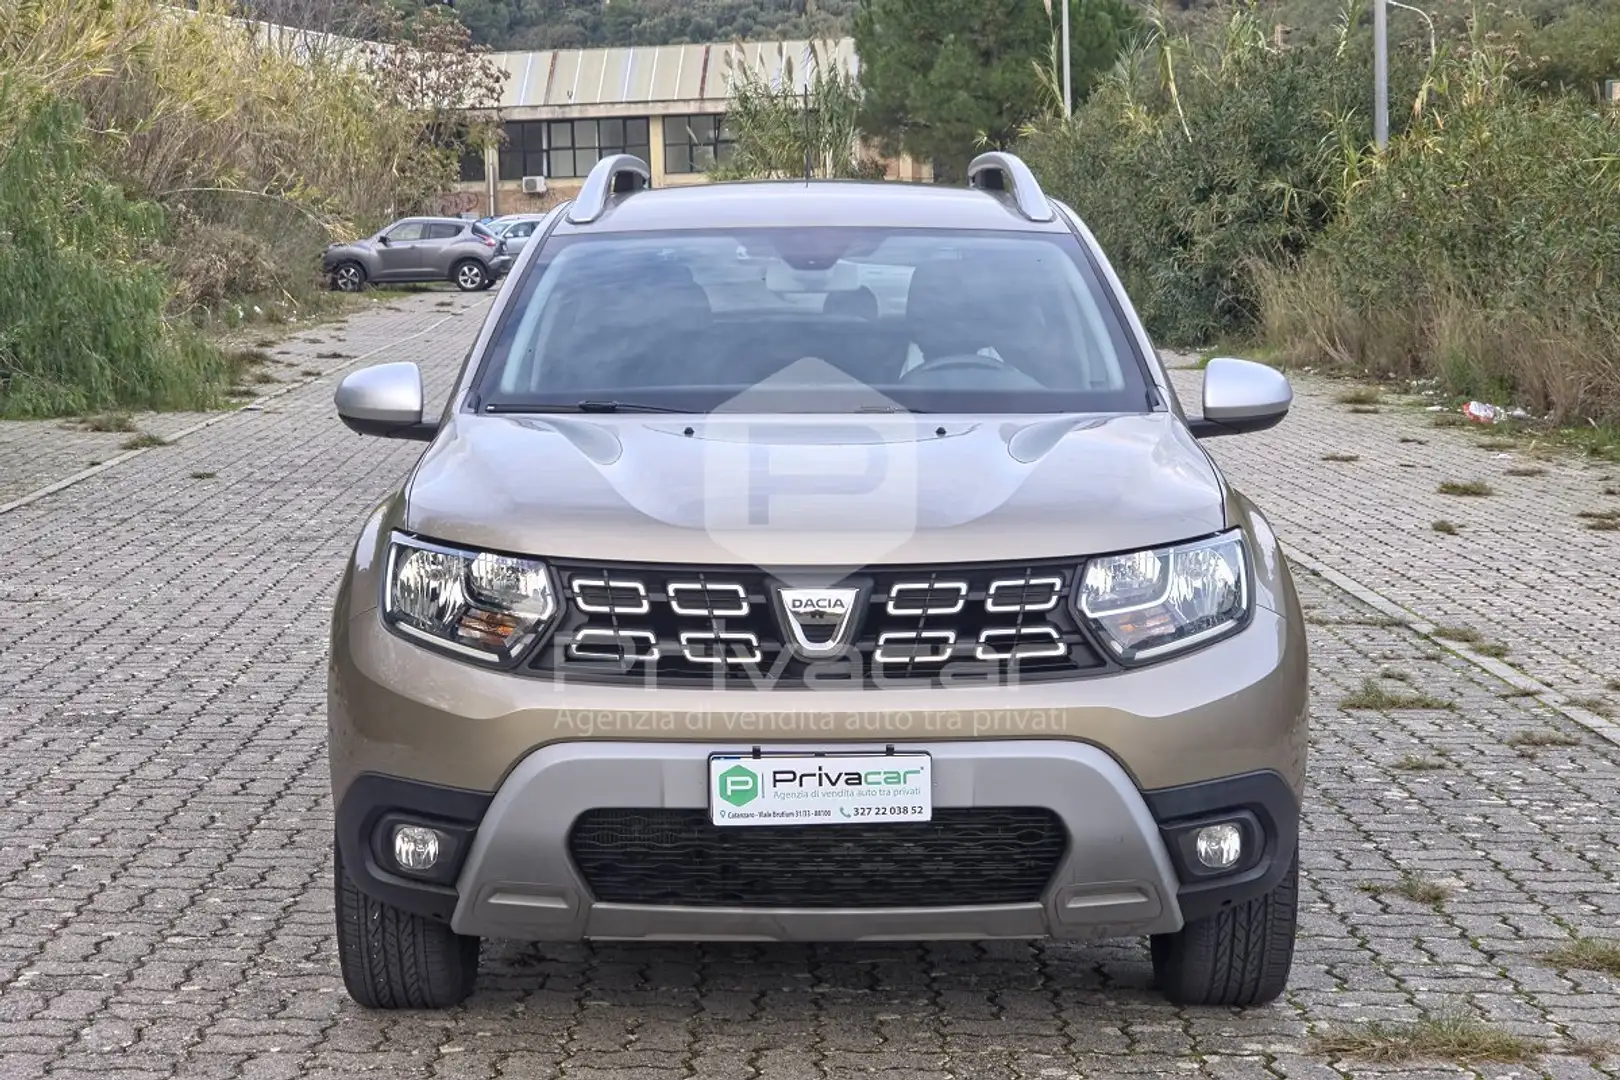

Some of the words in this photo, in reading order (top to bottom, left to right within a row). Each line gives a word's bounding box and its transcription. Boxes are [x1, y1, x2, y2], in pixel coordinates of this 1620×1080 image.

[791, 597, 846, 611] DACIA
[773, 766, 921, 787] Privacar
[773, 790, 809, 800] Agenzia
[811, 789, 820, 798] di
[822, 788, 855, 798] vendita
[857, 788, 877, 796] auto
[879, 787, 891, 795] tra
[894, 786, 921, 796] privati
[853, 808, 871, 816] 327
[874, 807, 887, 815] 22
[889, 806, 908, 815] 038
[911, 806, 923, 814] 52
